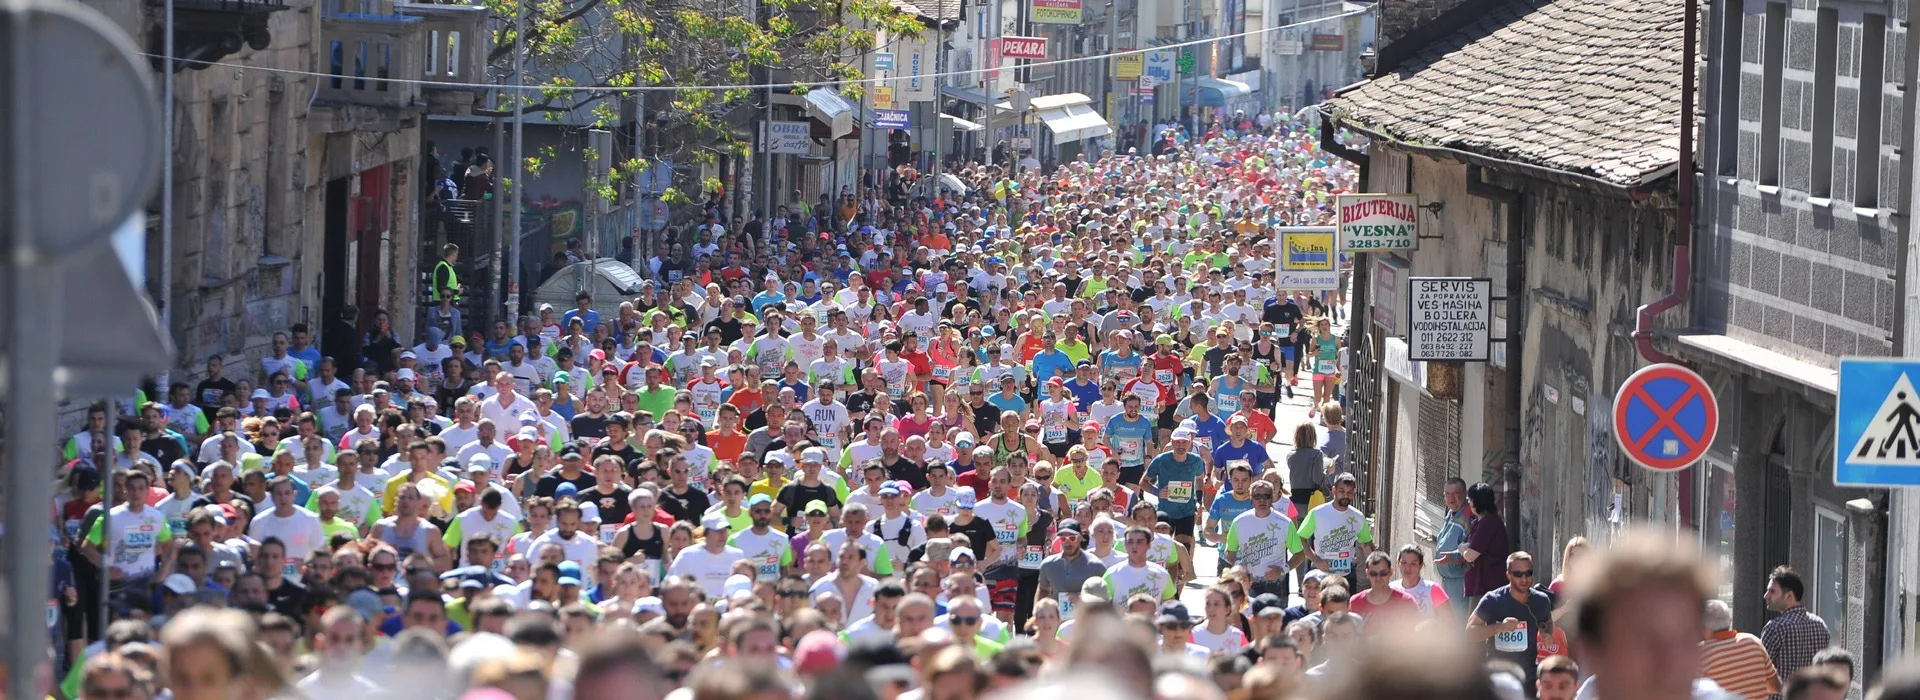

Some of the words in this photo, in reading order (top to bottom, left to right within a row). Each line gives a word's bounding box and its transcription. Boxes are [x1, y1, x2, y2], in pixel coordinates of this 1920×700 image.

[1036, 9, 1078, 19] FOTOKOPIRNICA
[1003, 40, 1044, 56] PEKARA
[1342, 198, 1416, 223] BIŽUTERIJA
[1348, 239, 1410, 248] 3283-710
[1421, 282, 1475, 292] SERVIS
[1424, 311, 1477, 320] BOJLERA
[1414, 322, 1486, 331] VODOINSTALACIJA
[1421, 332, 1433, 342] 011
[1437, 332, 1458, 342] 2622
[1460, 332, 1473, 342] 312
[815, 409, 835, 421] RUN
[128, 533, 150, 542] 2524
[996, 531, 1014, 539] 2574
[1498, 632, 1523, 642] 4860
